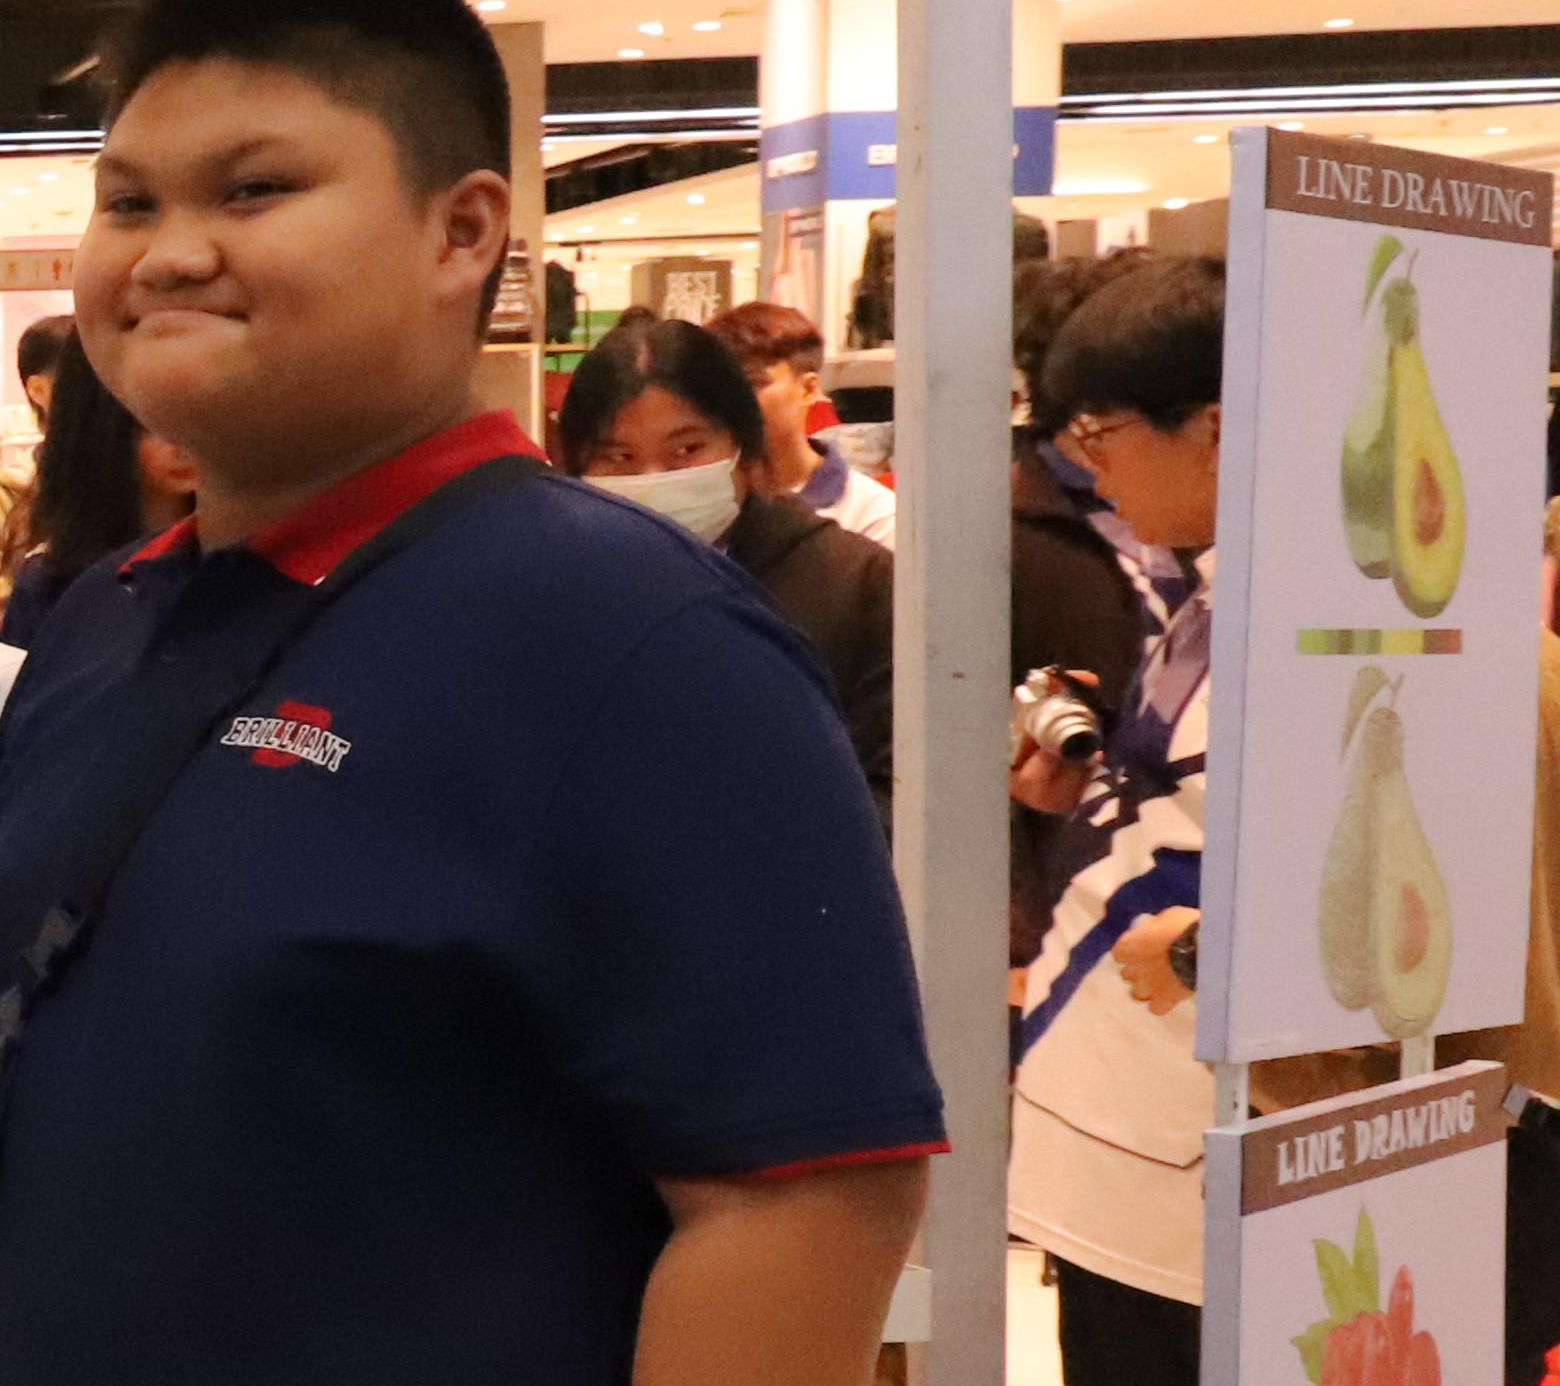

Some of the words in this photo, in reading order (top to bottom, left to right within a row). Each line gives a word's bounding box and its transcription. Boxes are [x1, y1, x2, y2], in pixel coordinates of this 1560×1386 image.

[1296, 156, 1373, 205] LINE
[1380, 169, 1536, 229] DRAWING
[221, 717, 352, 773] BRILLIANT
[1276, 1124, 1347, 1187] LINE
[1352, 1089, 1477, 1165] DRAWING
